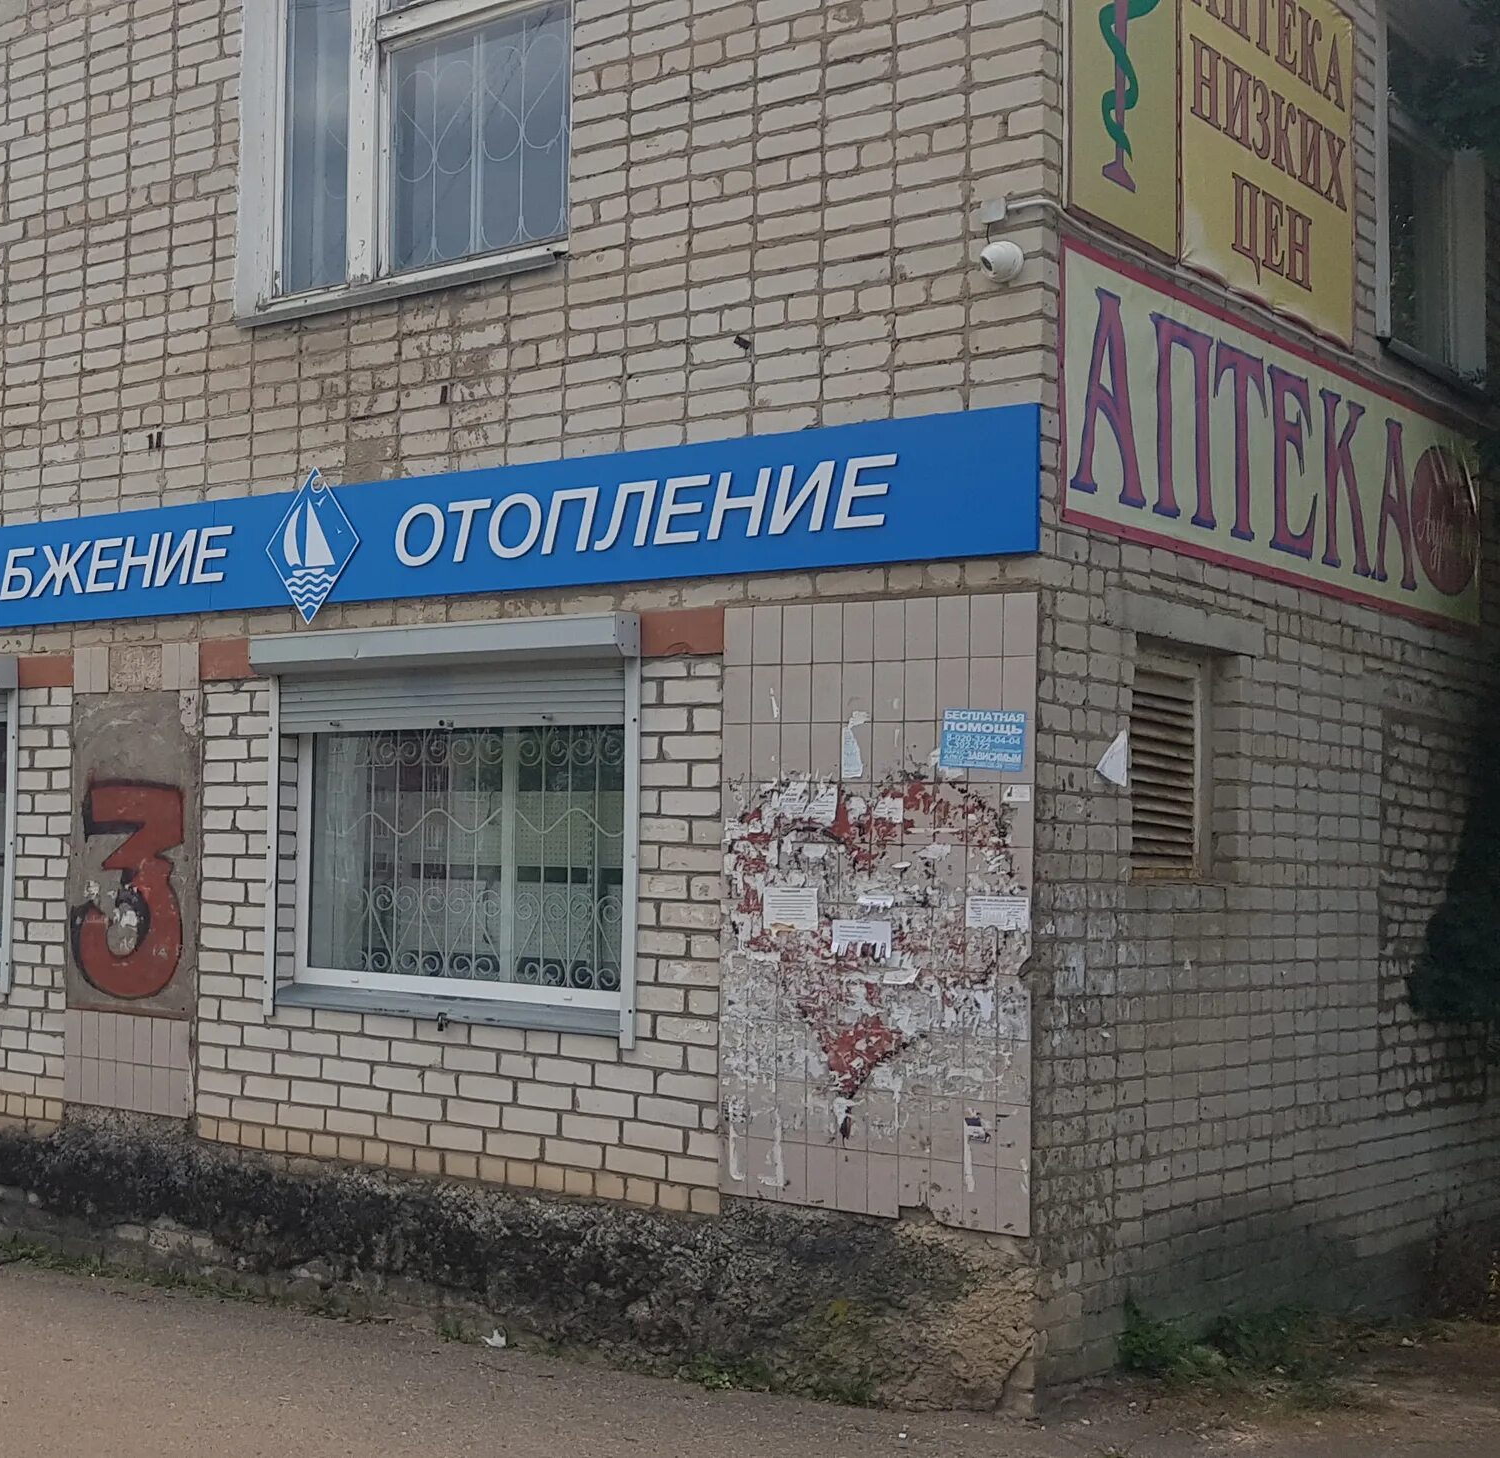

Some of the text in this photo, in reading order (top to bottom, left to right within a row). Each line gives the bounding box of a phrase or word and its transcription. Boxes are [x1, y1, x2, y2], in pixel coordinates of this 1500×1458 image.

[1186, 0, 1345, 112] ТЕКА
[1190, 34, 1347, 212] НИЗКИХ
[1232, 172, 1312, 292] ЦЕН
[1070, 286, 1417, 591] АПТЕКА
[394, 453, 898, 568] ОТОПЛЕНИЕ
[943, 720, 1023, 735] ПОМОЩЬ
[944, 710, 1025, 723] БЕСПЛАТНАЯ
